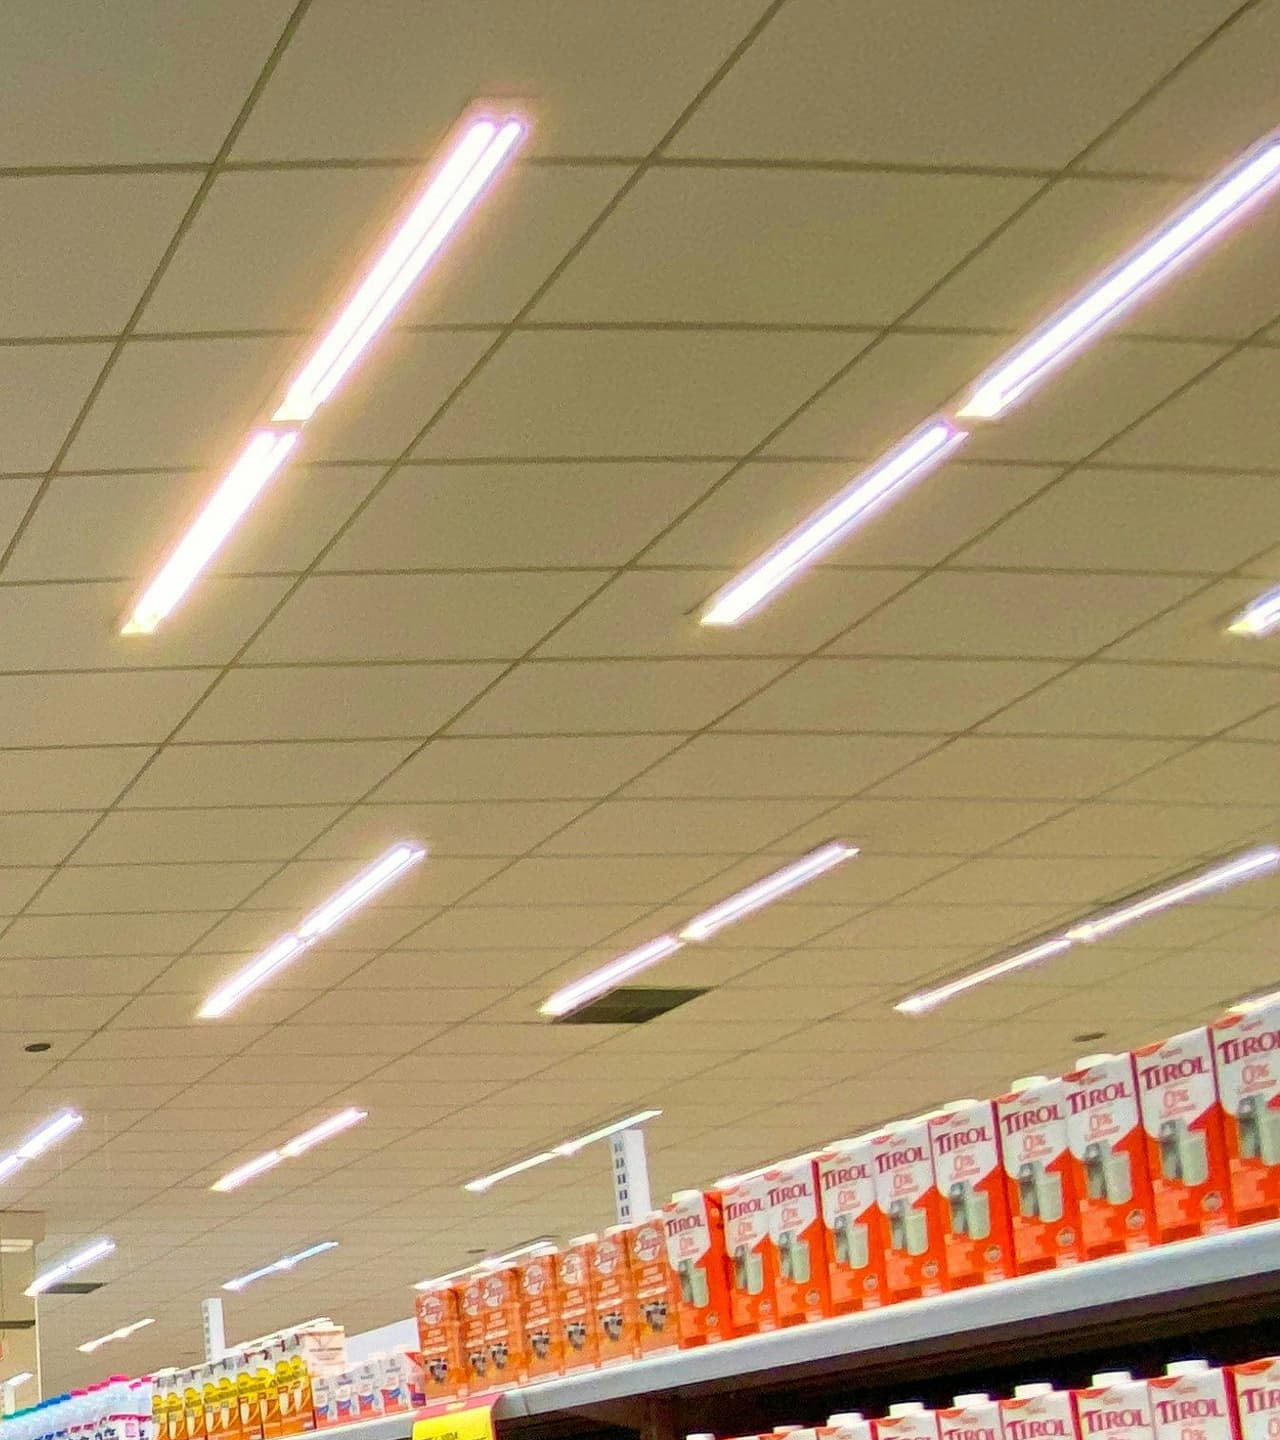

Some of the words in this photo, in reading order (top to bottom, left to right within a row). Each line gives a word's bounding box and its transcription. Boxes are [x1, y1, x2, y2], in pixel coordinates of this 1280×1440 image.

[1139, 1056, 1210, 1090] TIROL
[1066, 1082, 1132, 1115] TIROL
[1002, 1104, 1066, 1136] TIROL
[934, 1126, 992, 1154] TIROL
[875, 1146, 929, 1174] TIROL
[821, 1164, 870, 1190] TIROL
[767, 1183, 812, 1207] TIROL
[1082, 1408, 1150, 1432] TIROL
[1156, 1399, 1224, 1424] TIROL
